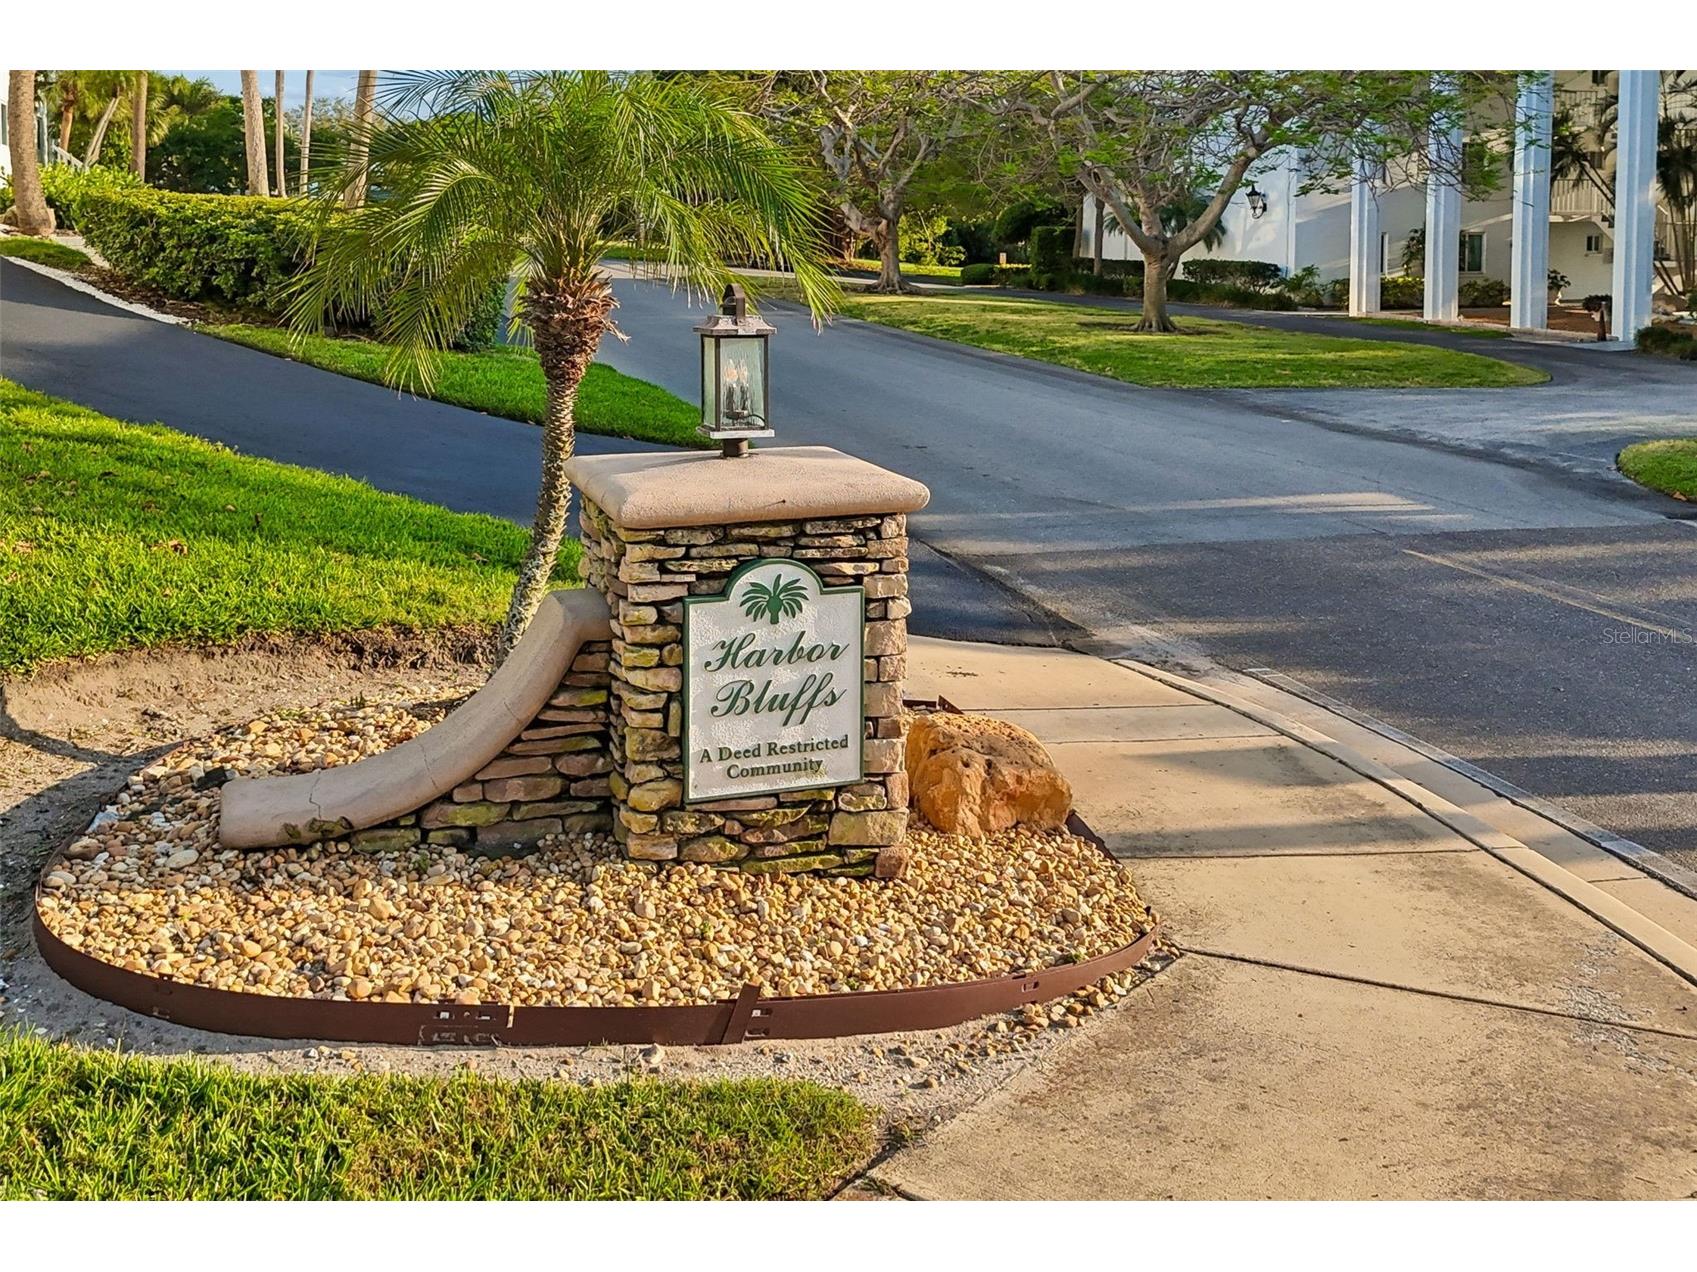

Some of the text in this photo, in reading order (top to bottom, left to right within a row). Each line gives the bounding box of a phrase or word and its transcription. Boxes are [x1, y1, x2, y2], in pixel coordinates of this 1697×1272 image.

[704, 631, 850, 673] Harbor
[711, 672, 847, 727] Bluffs
[700, 734, 849, 763] A Deed Restricted
[727, 757, 823, 779] Community
